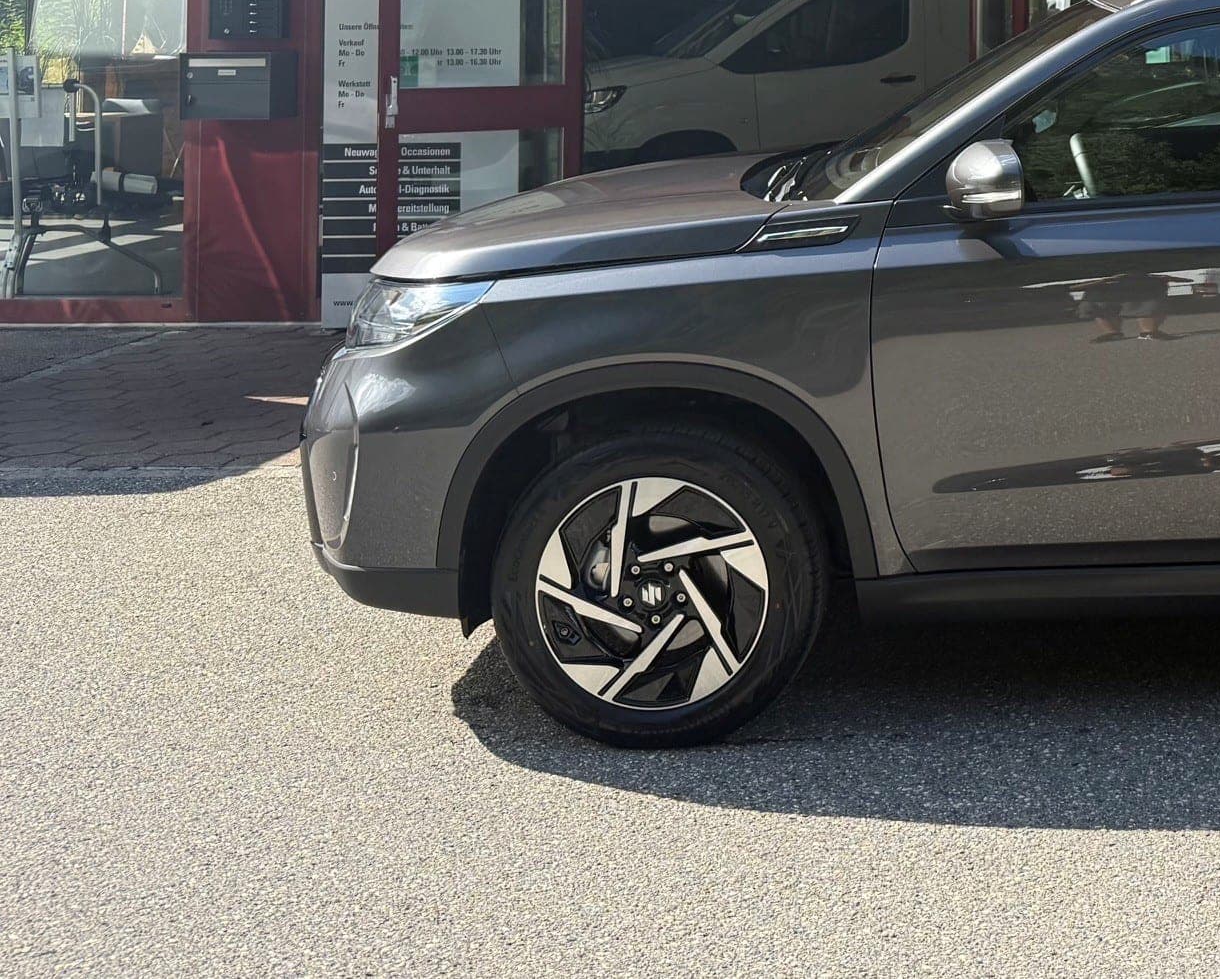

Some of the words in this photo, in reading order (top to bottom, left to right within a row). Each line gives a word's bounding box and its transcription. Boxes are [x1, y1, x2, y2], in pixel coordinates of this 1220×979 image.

[338, 39, 364, 47] Verkauf
[338, 49, 350, 57] Mo
[430, 48, 443, 56] Uhr
[446, 48, 464, 56] 13.00
[488, 48, 502, 56] Uhr
[488, 58, 502, 66] Uhr
[338, 80, 371, 88] Werkstatt
[337, 90, 350, 98] Mo
[355, 90, 365, 98] Do
[344, 147, 378, 158] Neuwag
[401, 146, 451, 156] Occasionen
[402, 165, 410, 175] &
[412, 165, 451, 175] Unterhalt
[402, 221, 409, 231] &
